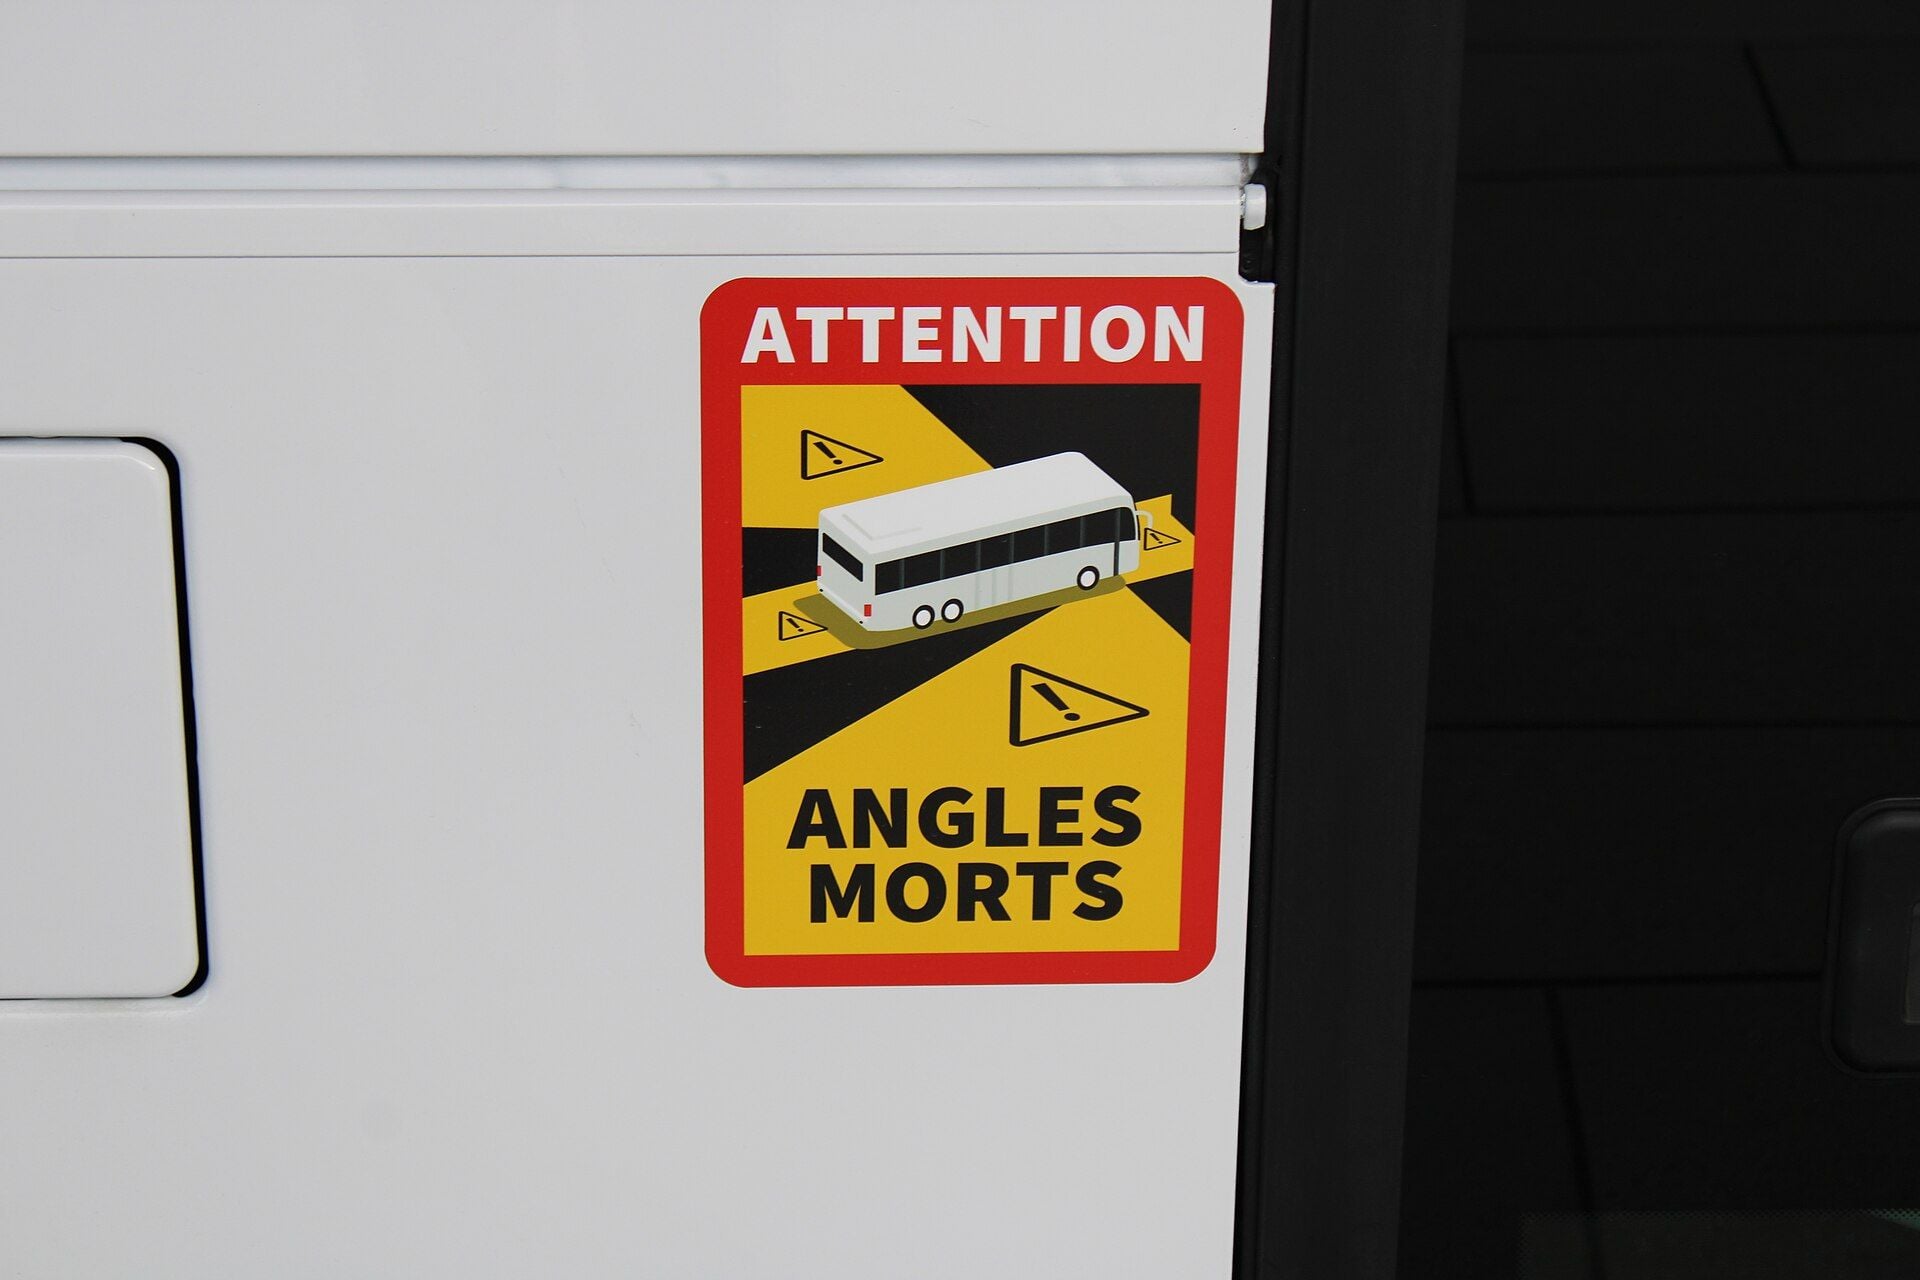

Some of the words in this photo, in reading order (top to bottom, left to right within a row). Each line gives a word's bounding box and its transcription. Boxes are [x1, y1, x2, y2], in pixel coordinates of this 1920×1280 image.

[741, 305, 1204, 363] ATTENTION
[786, 785, 1142, 849] ANGLES
[810, 860, 1123, 923] MORTS
